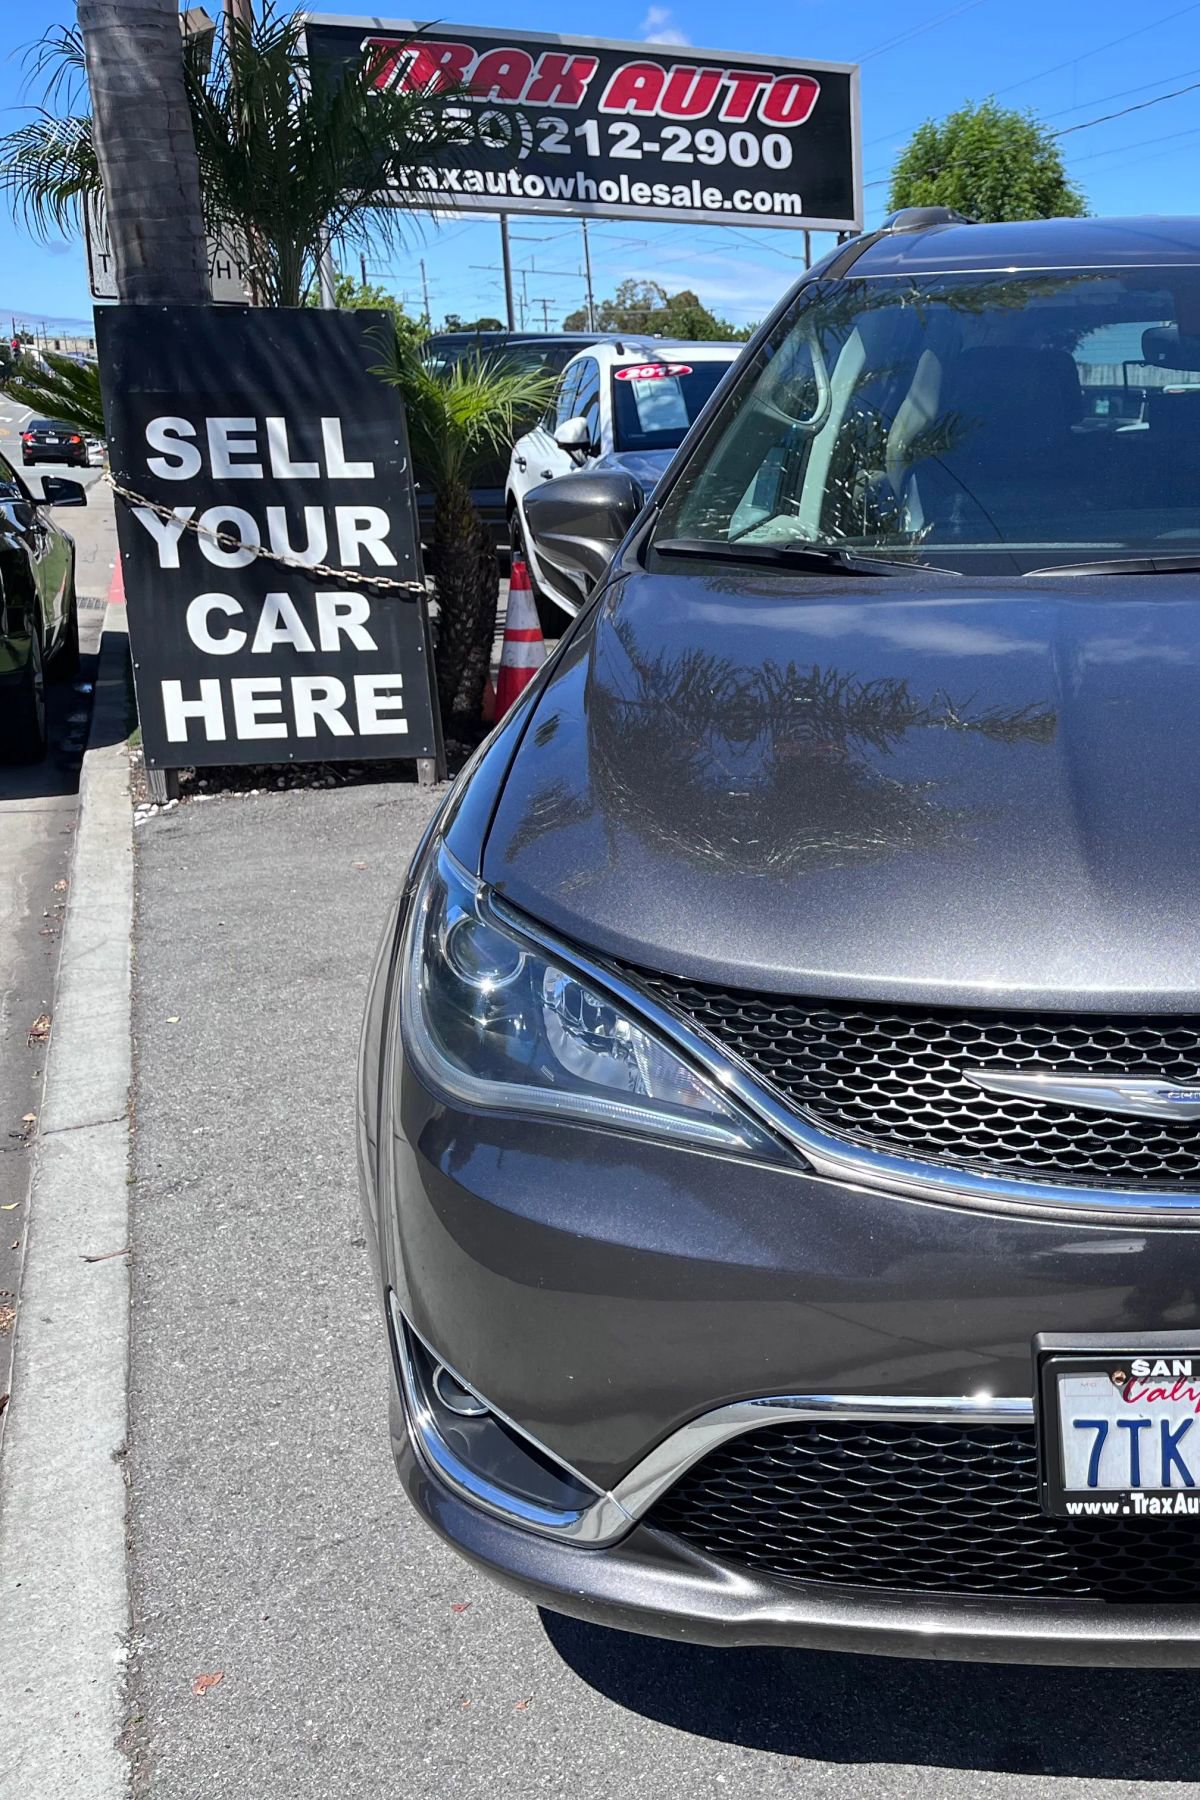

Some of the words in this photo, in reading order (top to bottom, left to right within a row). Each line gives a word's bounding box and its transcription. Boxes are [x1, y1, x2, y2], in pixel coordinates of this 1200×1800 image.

[357, 37, 599, 109] TRAX
[598, 61, 820, 127] AUTO
[624, 366, 682, 379] 2017
[145, 416, 375, 481] SELL
[131, 505, 397, 569] YOUR
[186, 592, 378, 655] CAR
[161, 674, 409, 743] HERE
[1131, 1359, 1192, 1377] SAN
